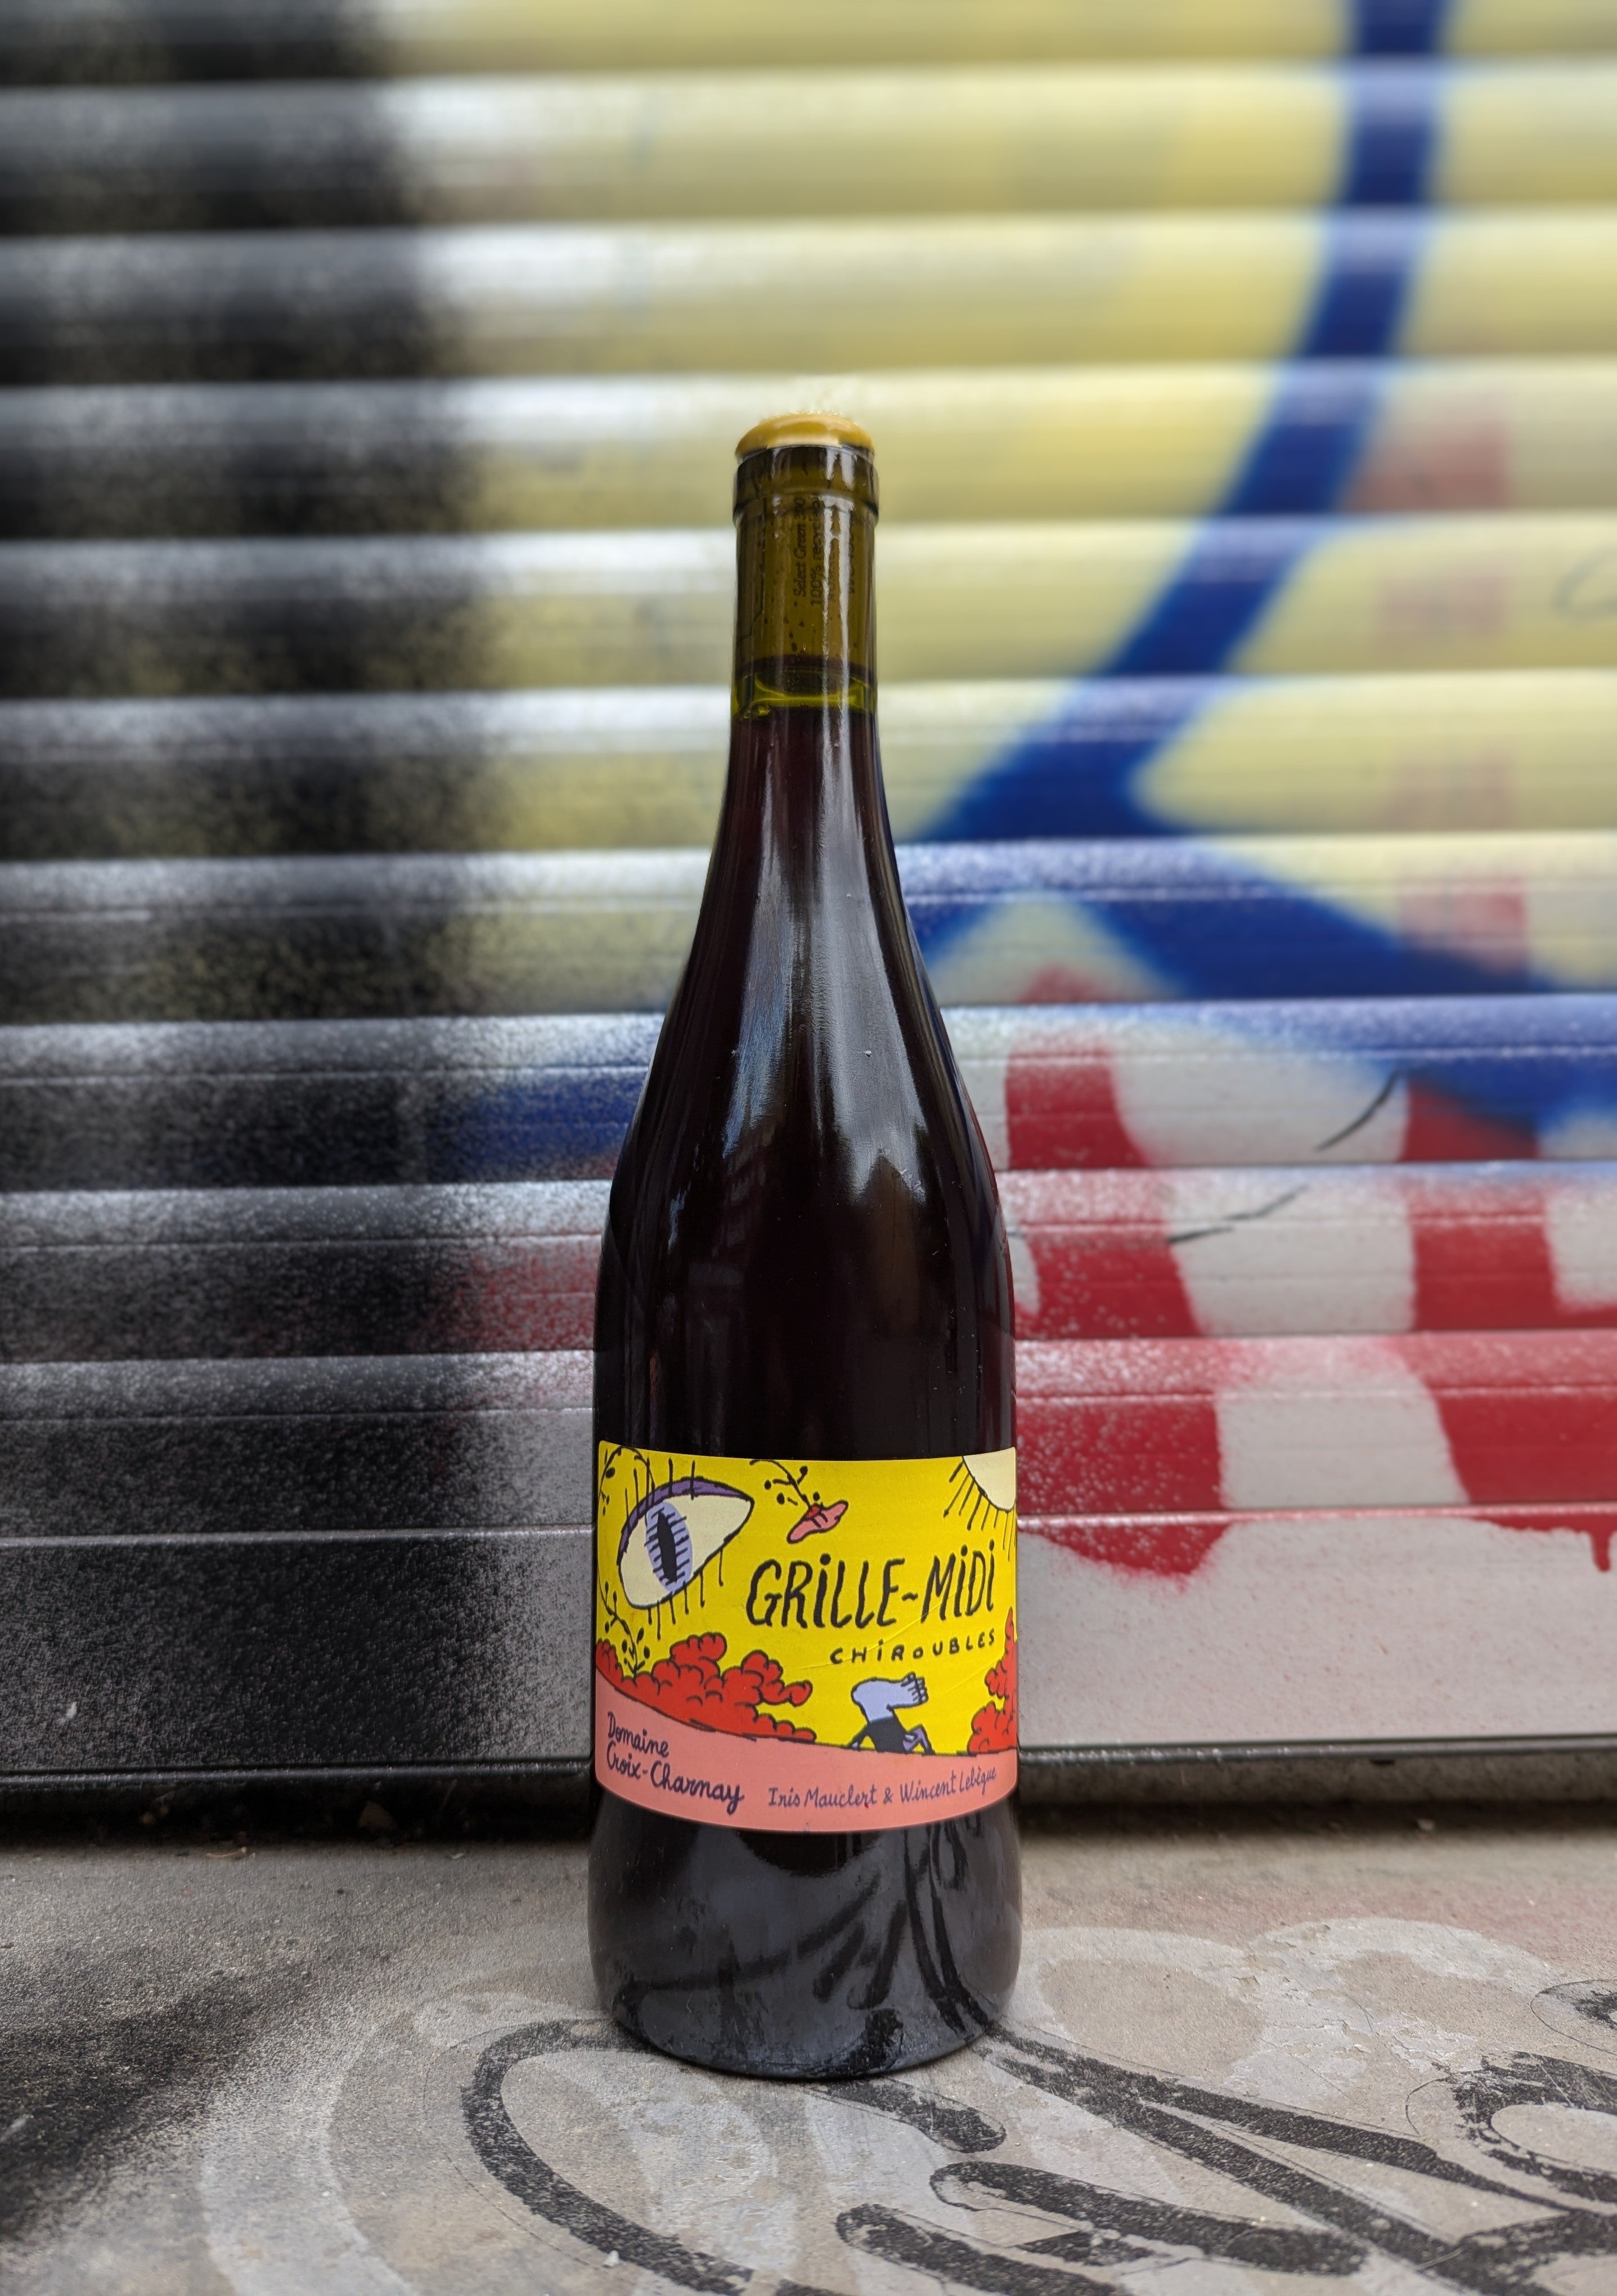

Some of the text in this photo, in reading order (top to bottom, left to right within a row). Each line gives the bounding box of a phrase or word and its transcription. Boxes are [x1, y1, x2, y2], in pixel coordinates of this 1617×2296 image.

[793, 523, 806, 559] Green
[810, 564, 823, 607] 100%
[607, 1711, 670, 1758] Domaine
[607, 1740, 745, 1815] Croix-Charnay
[768, 1786, 801, 1808] Iris
[803, 1783, 877, 1809] Mauclert
[883, 1786, 893, 1805] &
